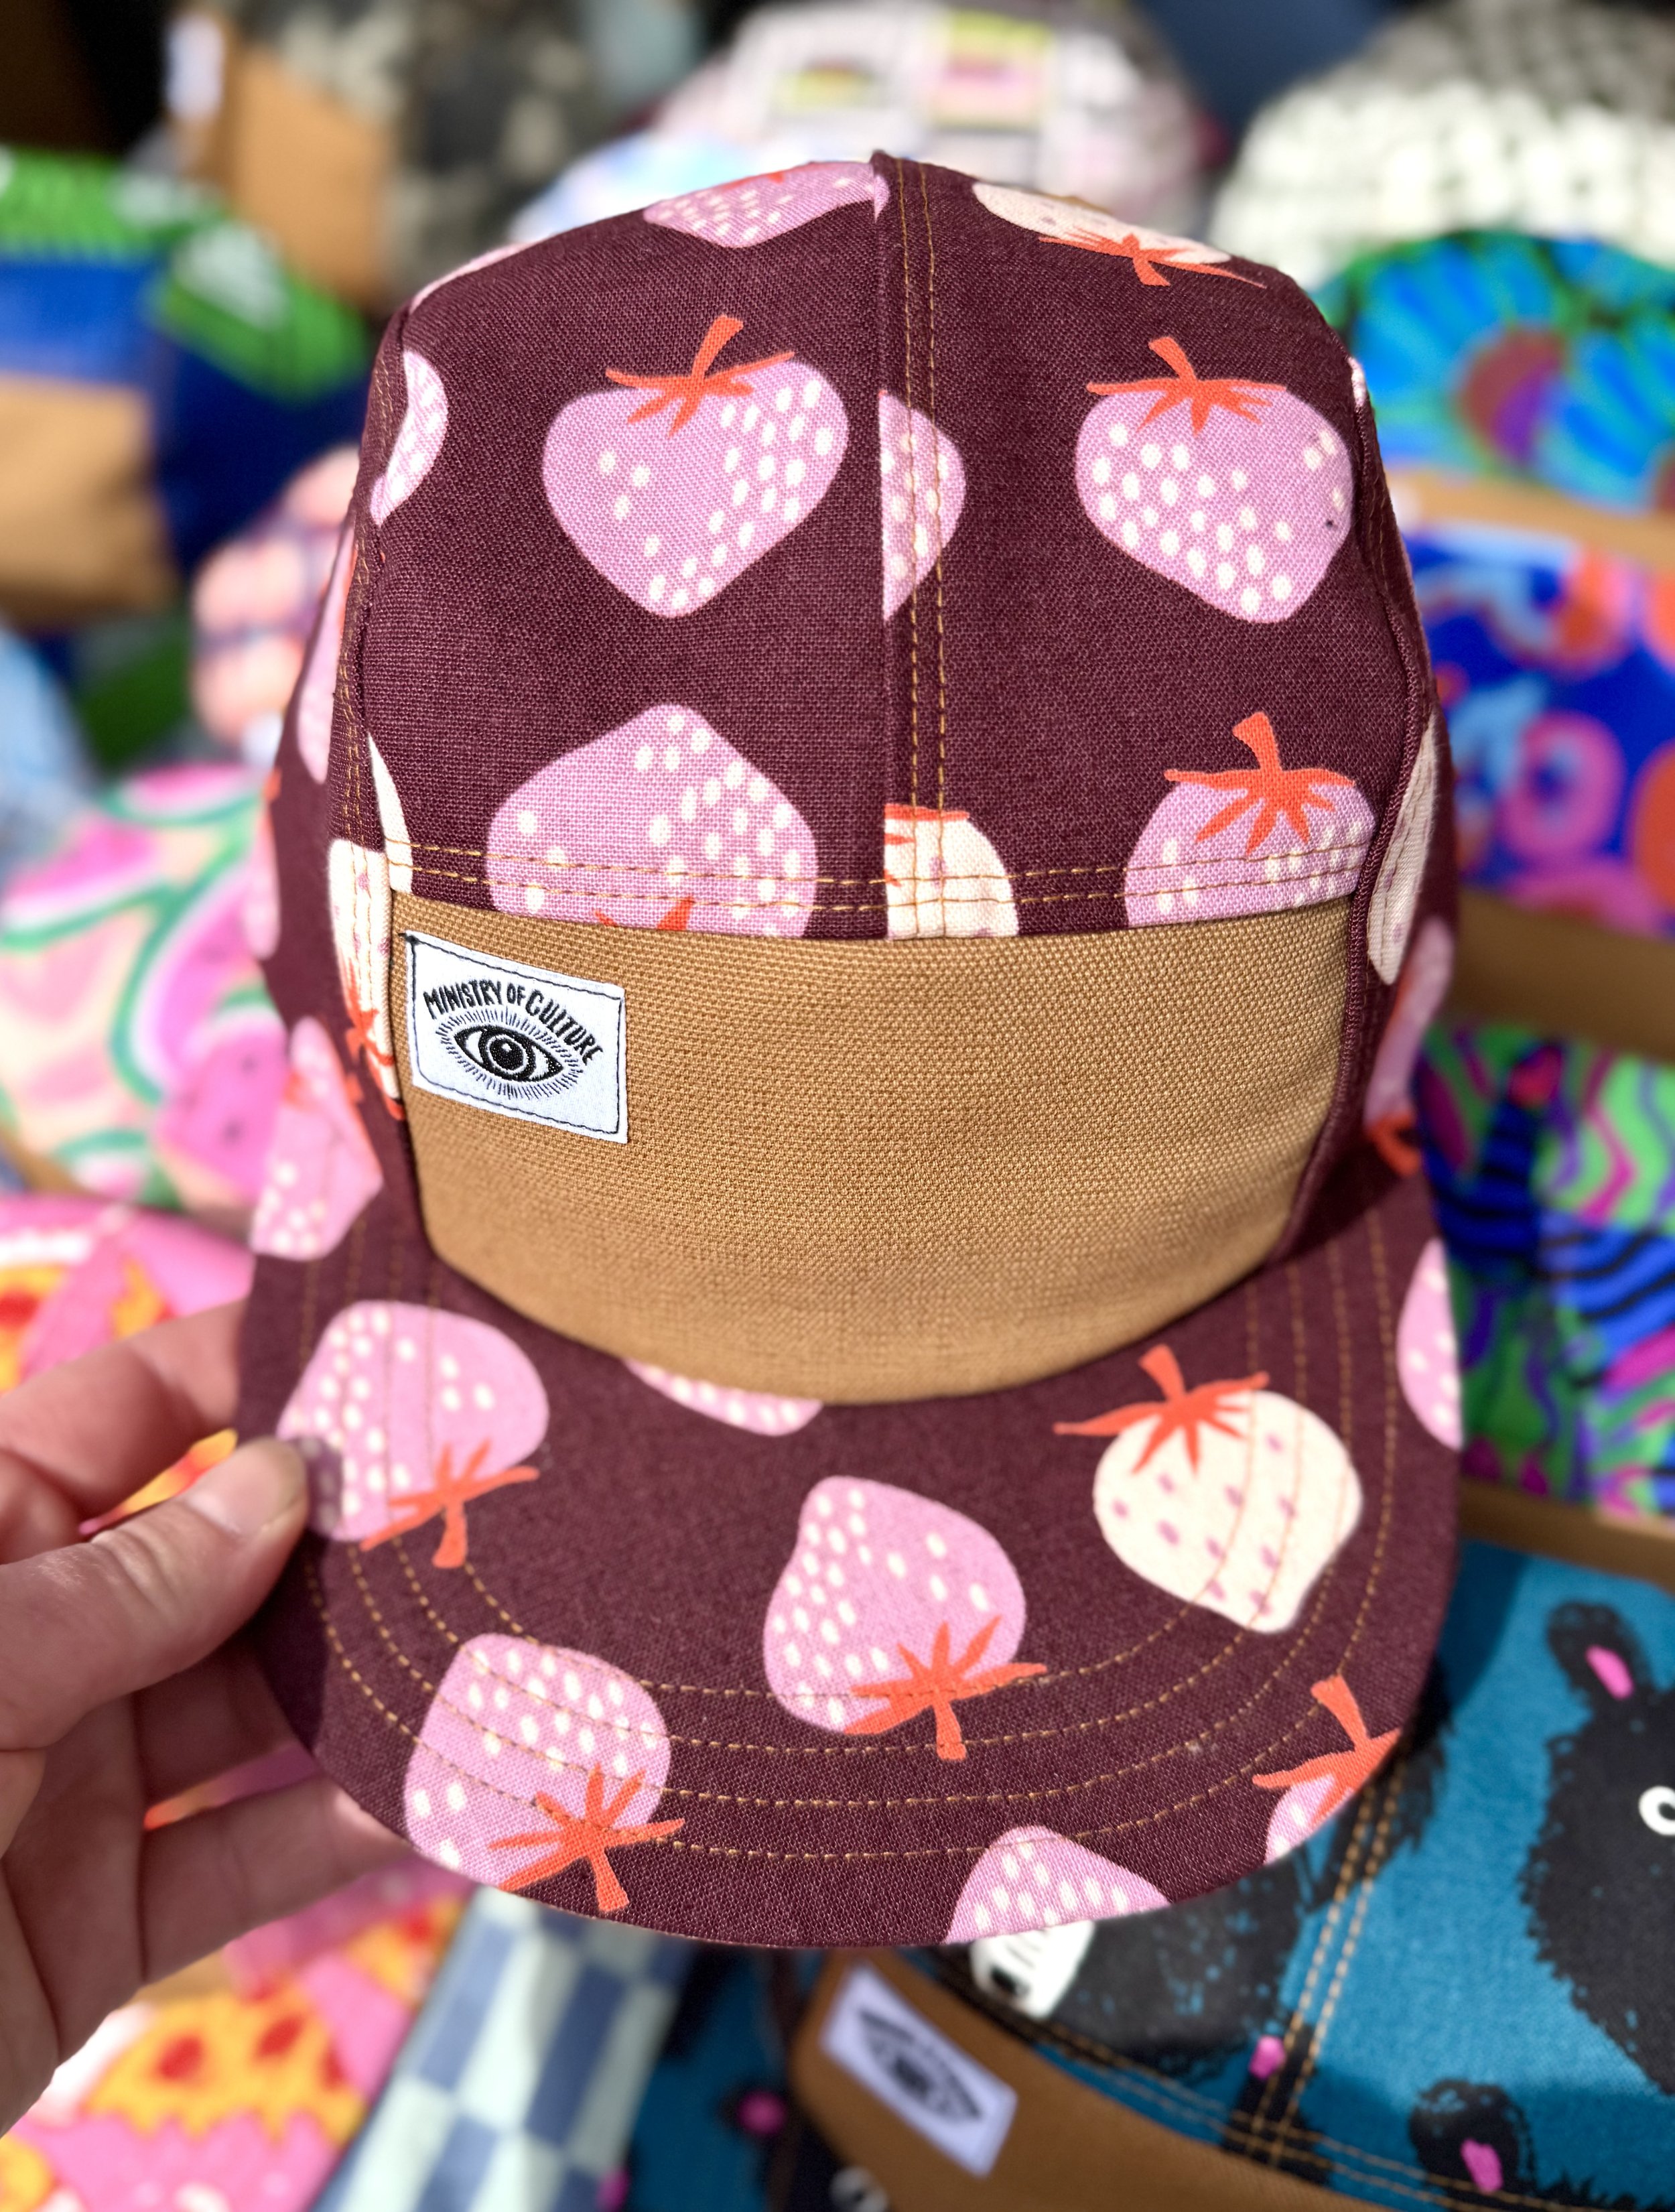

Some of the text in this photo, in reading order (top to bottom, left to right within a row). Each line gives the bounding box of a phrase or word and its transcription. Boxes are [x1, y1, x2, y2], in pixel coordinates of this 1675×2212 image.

[423, 979, 604, 1065] MINISTRY OF CULTURE
